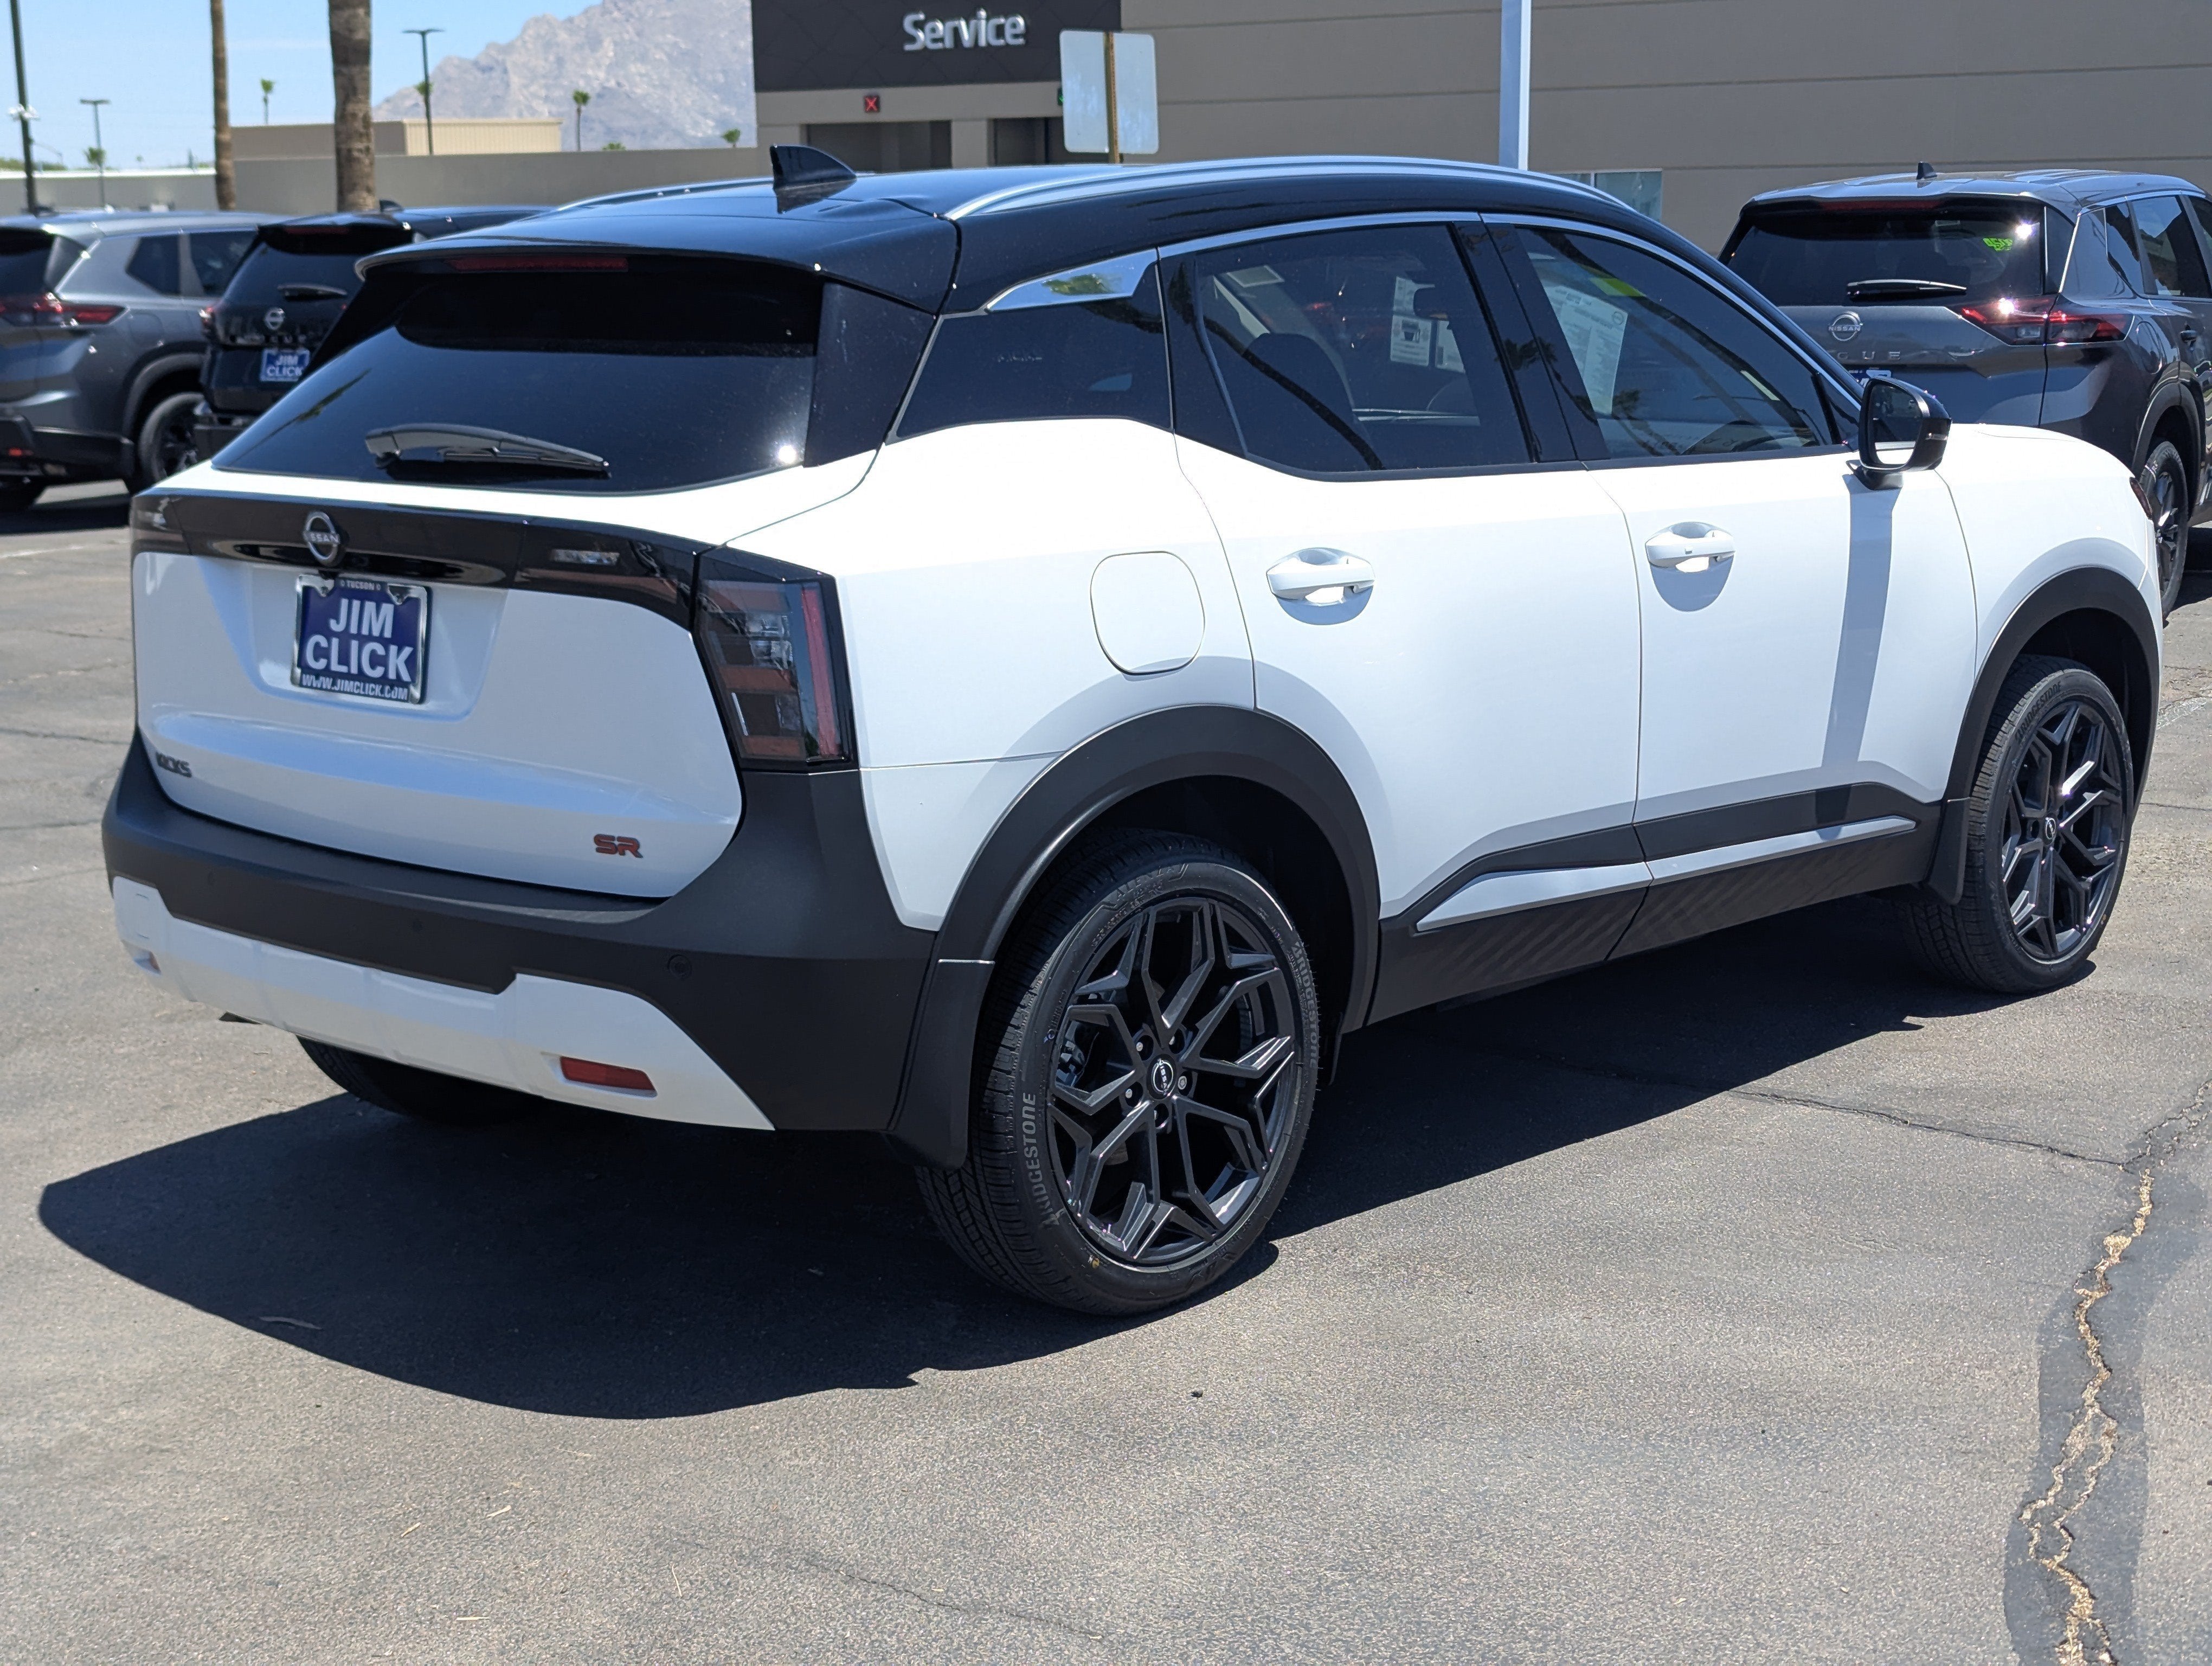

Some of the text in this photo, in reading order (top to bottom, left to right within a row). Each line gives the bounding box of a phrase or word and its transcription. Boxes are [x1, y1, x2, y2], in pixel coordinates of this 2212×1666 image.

[903, 9, 1026, 51] Service
[275, 355, 298, 366] JIM
[329, 598, 395, 638] JIM
[306, 634, 414, 682] CLICK
[303, 674, 409, 700] WWW.JIMCLICK.COM
[594, 834, 644, 858] SR
